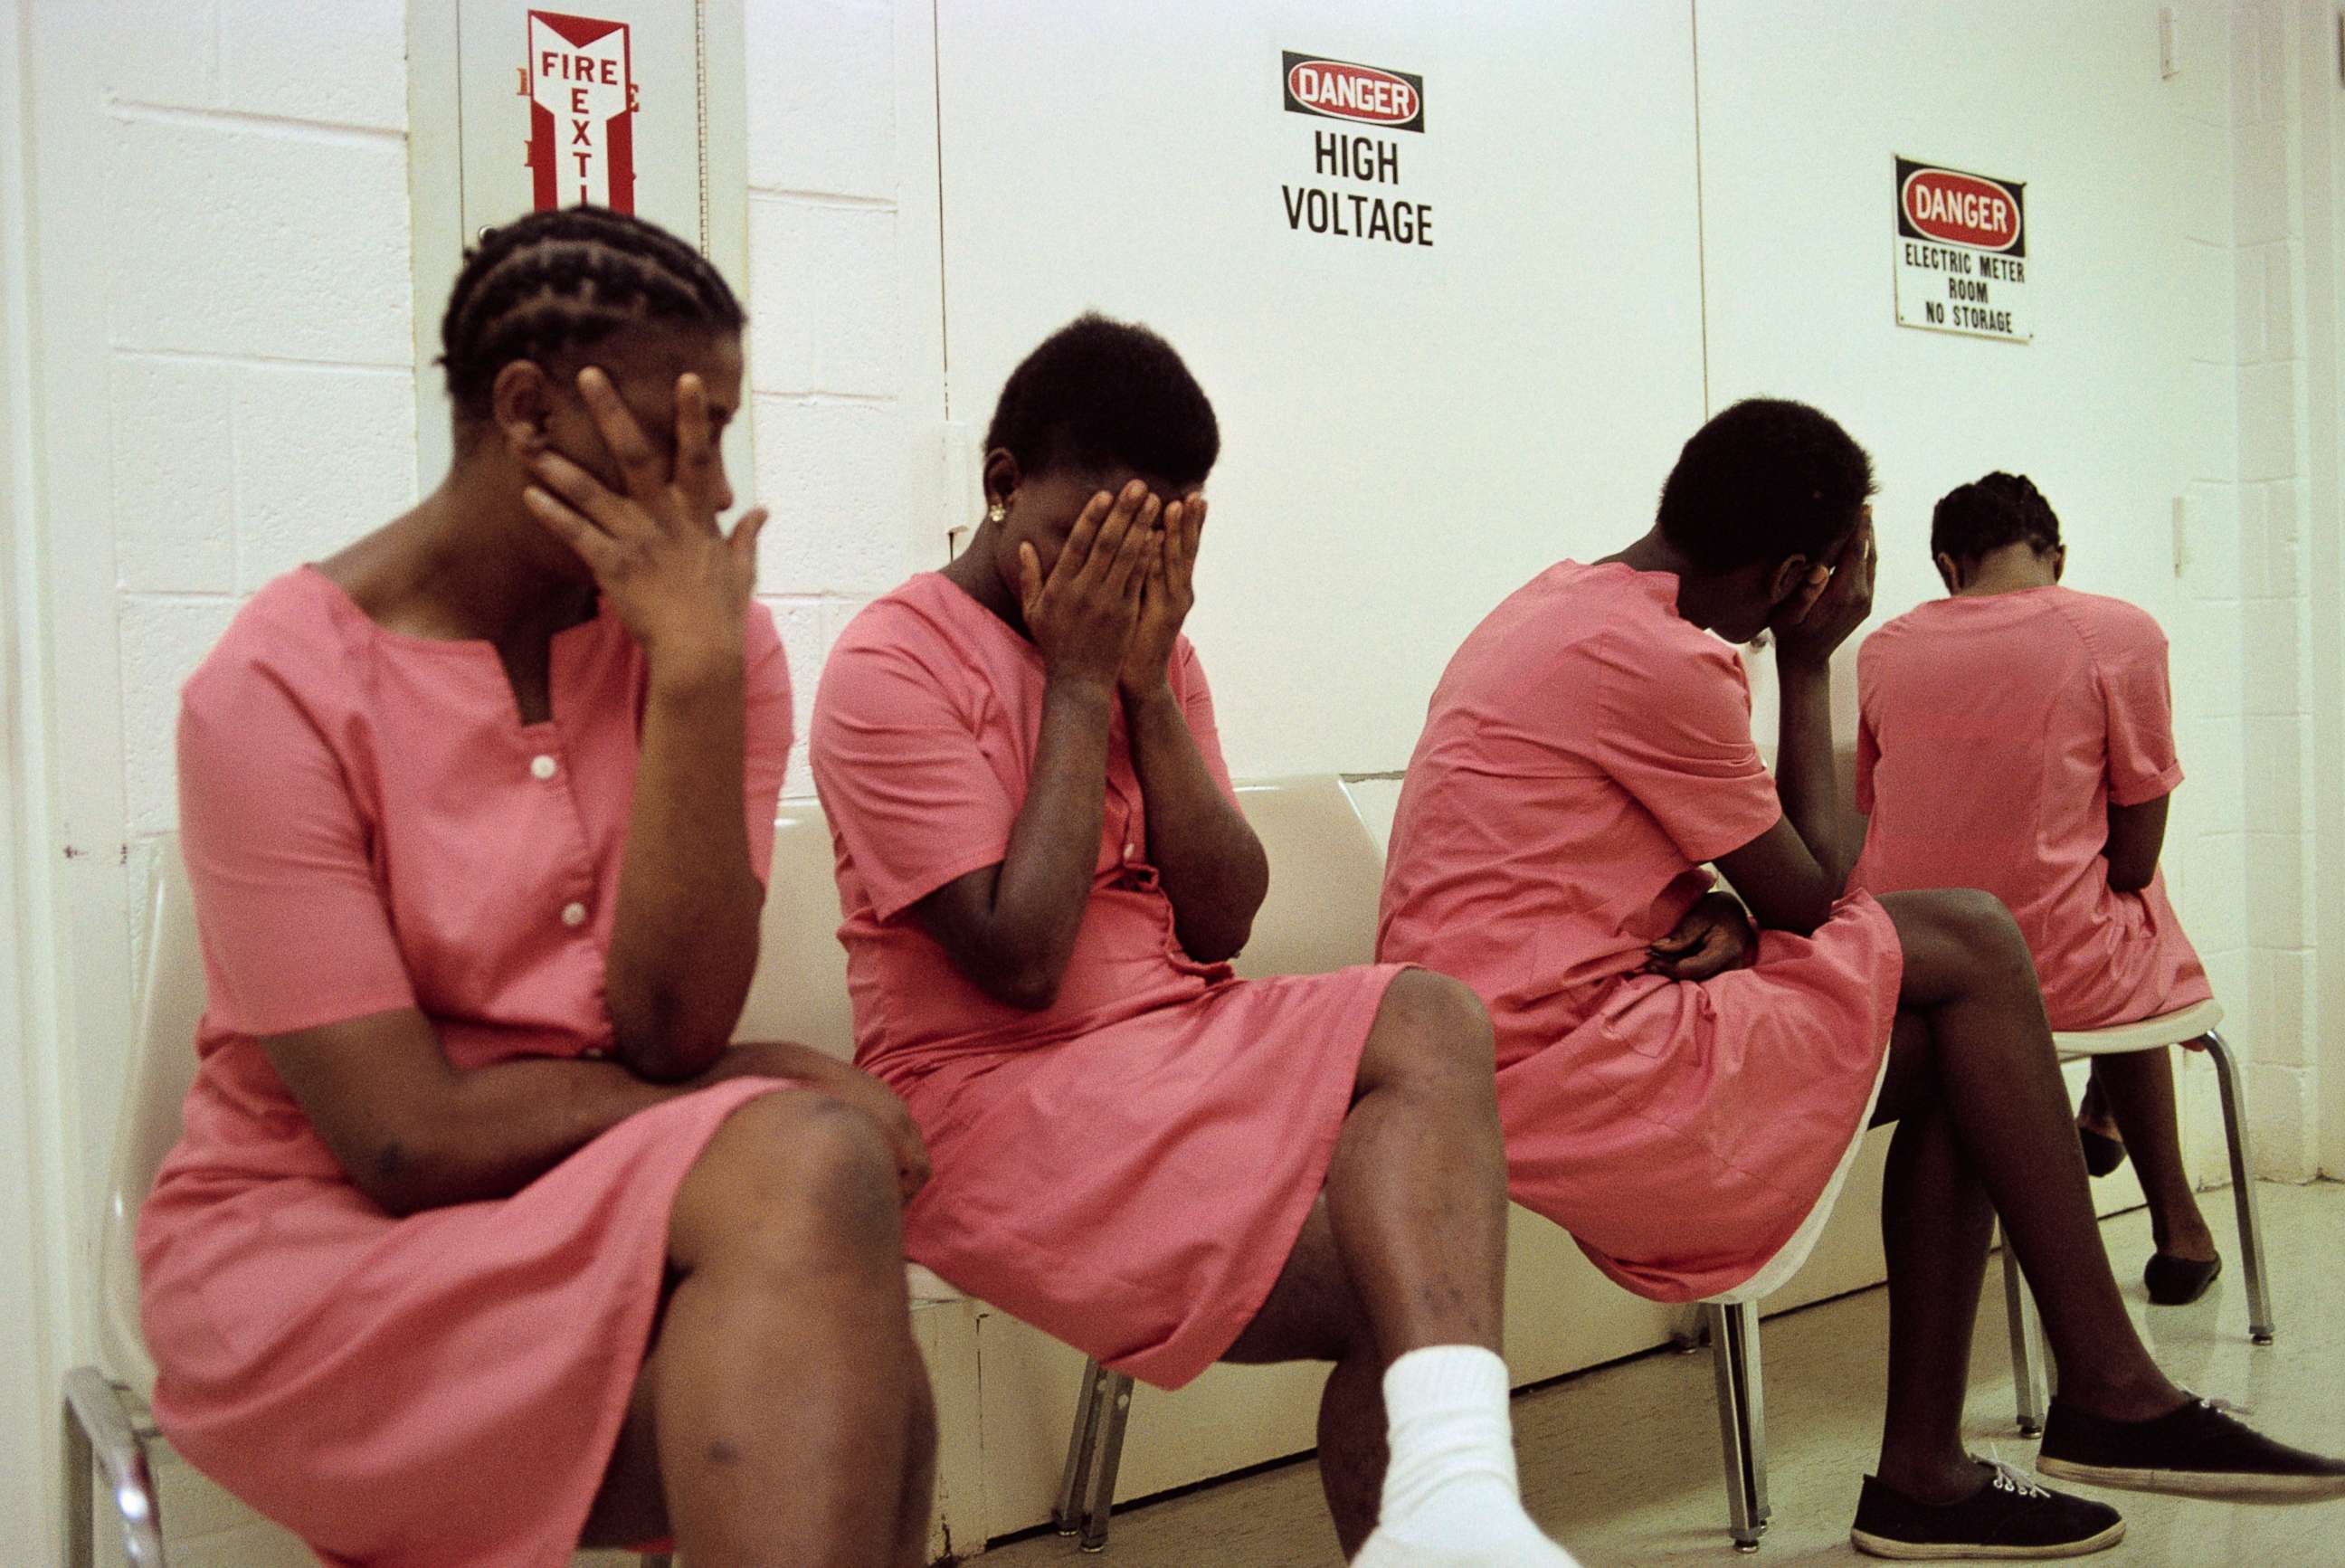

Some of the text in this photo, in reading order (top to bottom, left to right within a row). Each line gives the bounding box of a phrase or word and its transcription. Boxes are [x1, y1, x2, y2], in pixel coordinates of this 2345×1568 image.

[542, 51, 618, 85] FIRE
[1298, 67, 1410, 117] DANGER
[1315, 130, 1399, 185] HIGH
[1281, 185, 1434, 246] VOLTAGE
[1915, 184, 2008, 233] DANGER
[1905, 242, 2026, 283] ELECTRIC METER
[1949, 277, 1989, 304] ROOM
[1926, 301, 2013, 334] NO STORAGE
